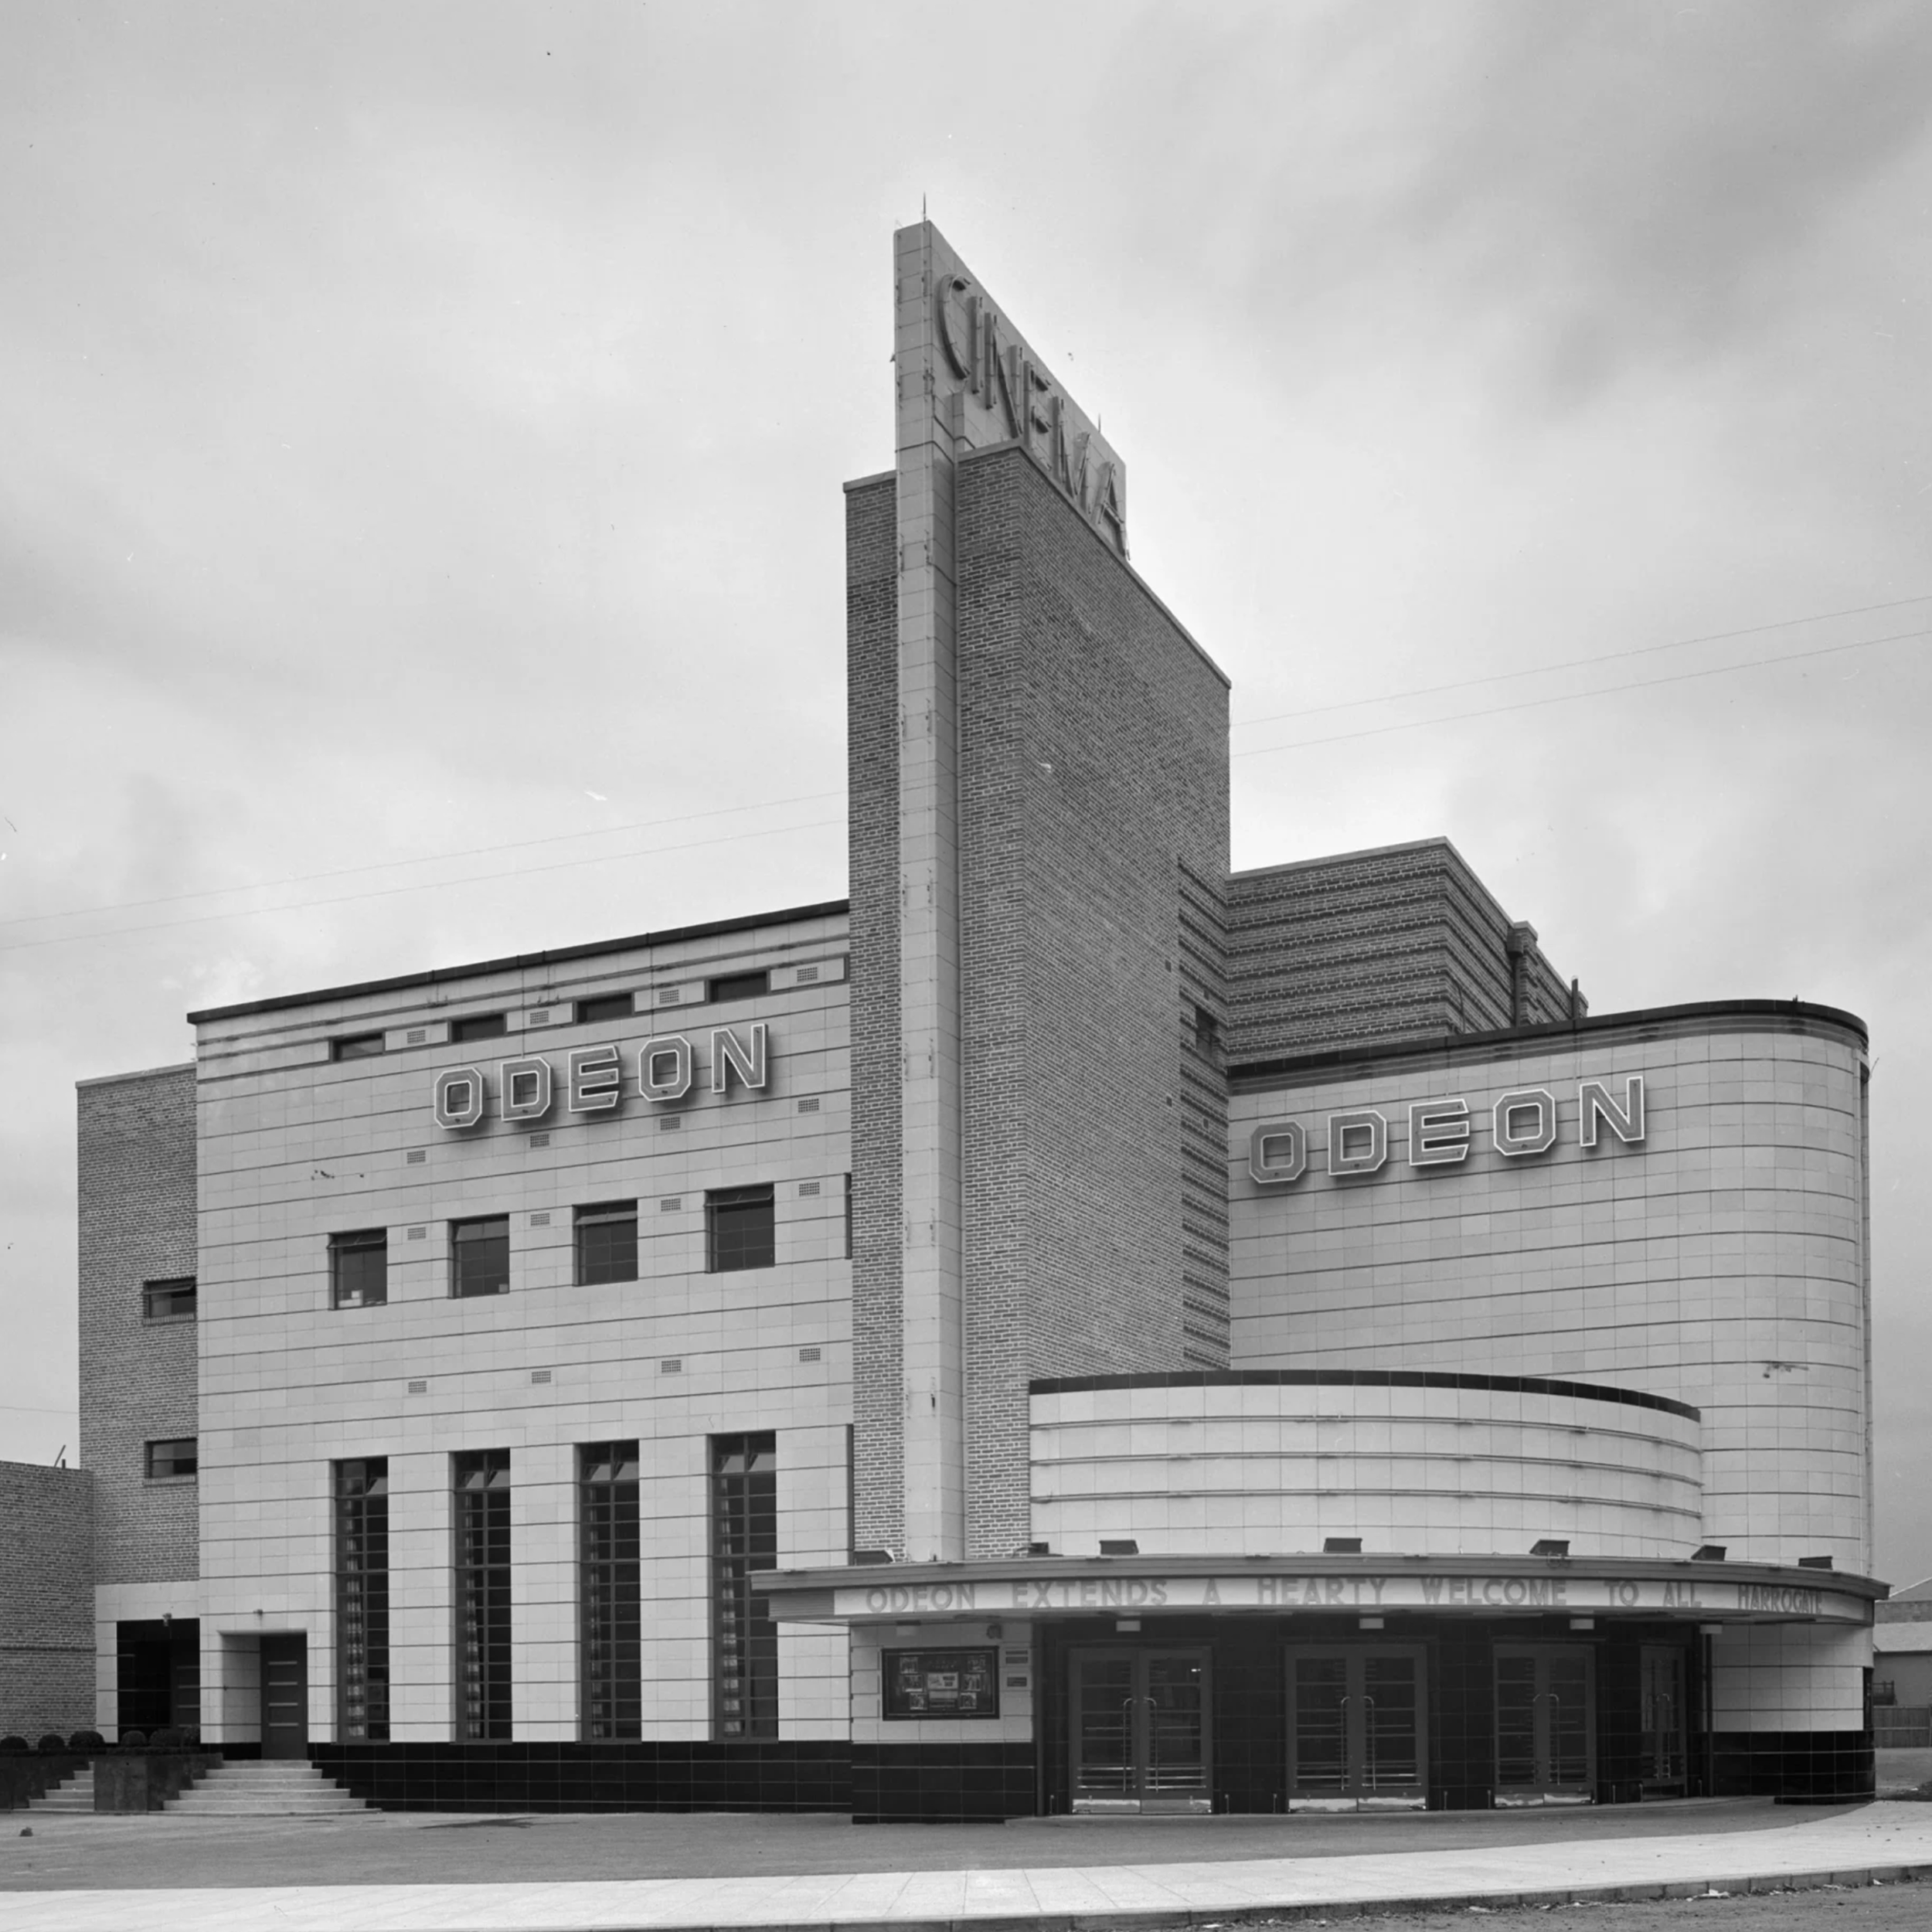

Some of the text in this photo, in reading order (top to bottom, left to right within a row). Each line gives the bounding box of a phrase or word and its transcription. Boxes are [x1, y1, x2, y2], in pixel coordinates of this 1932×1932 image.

[937, 273, 1131, 561] CINEMA
[434, 1023, 766, 1129] ODEON
[1249, 1076, 1645, 1183] ODEON
[865, 1577, 1823, 1614] ODEON EXTENDS A HEARTY WELCOME TO ALL HARROGATE
